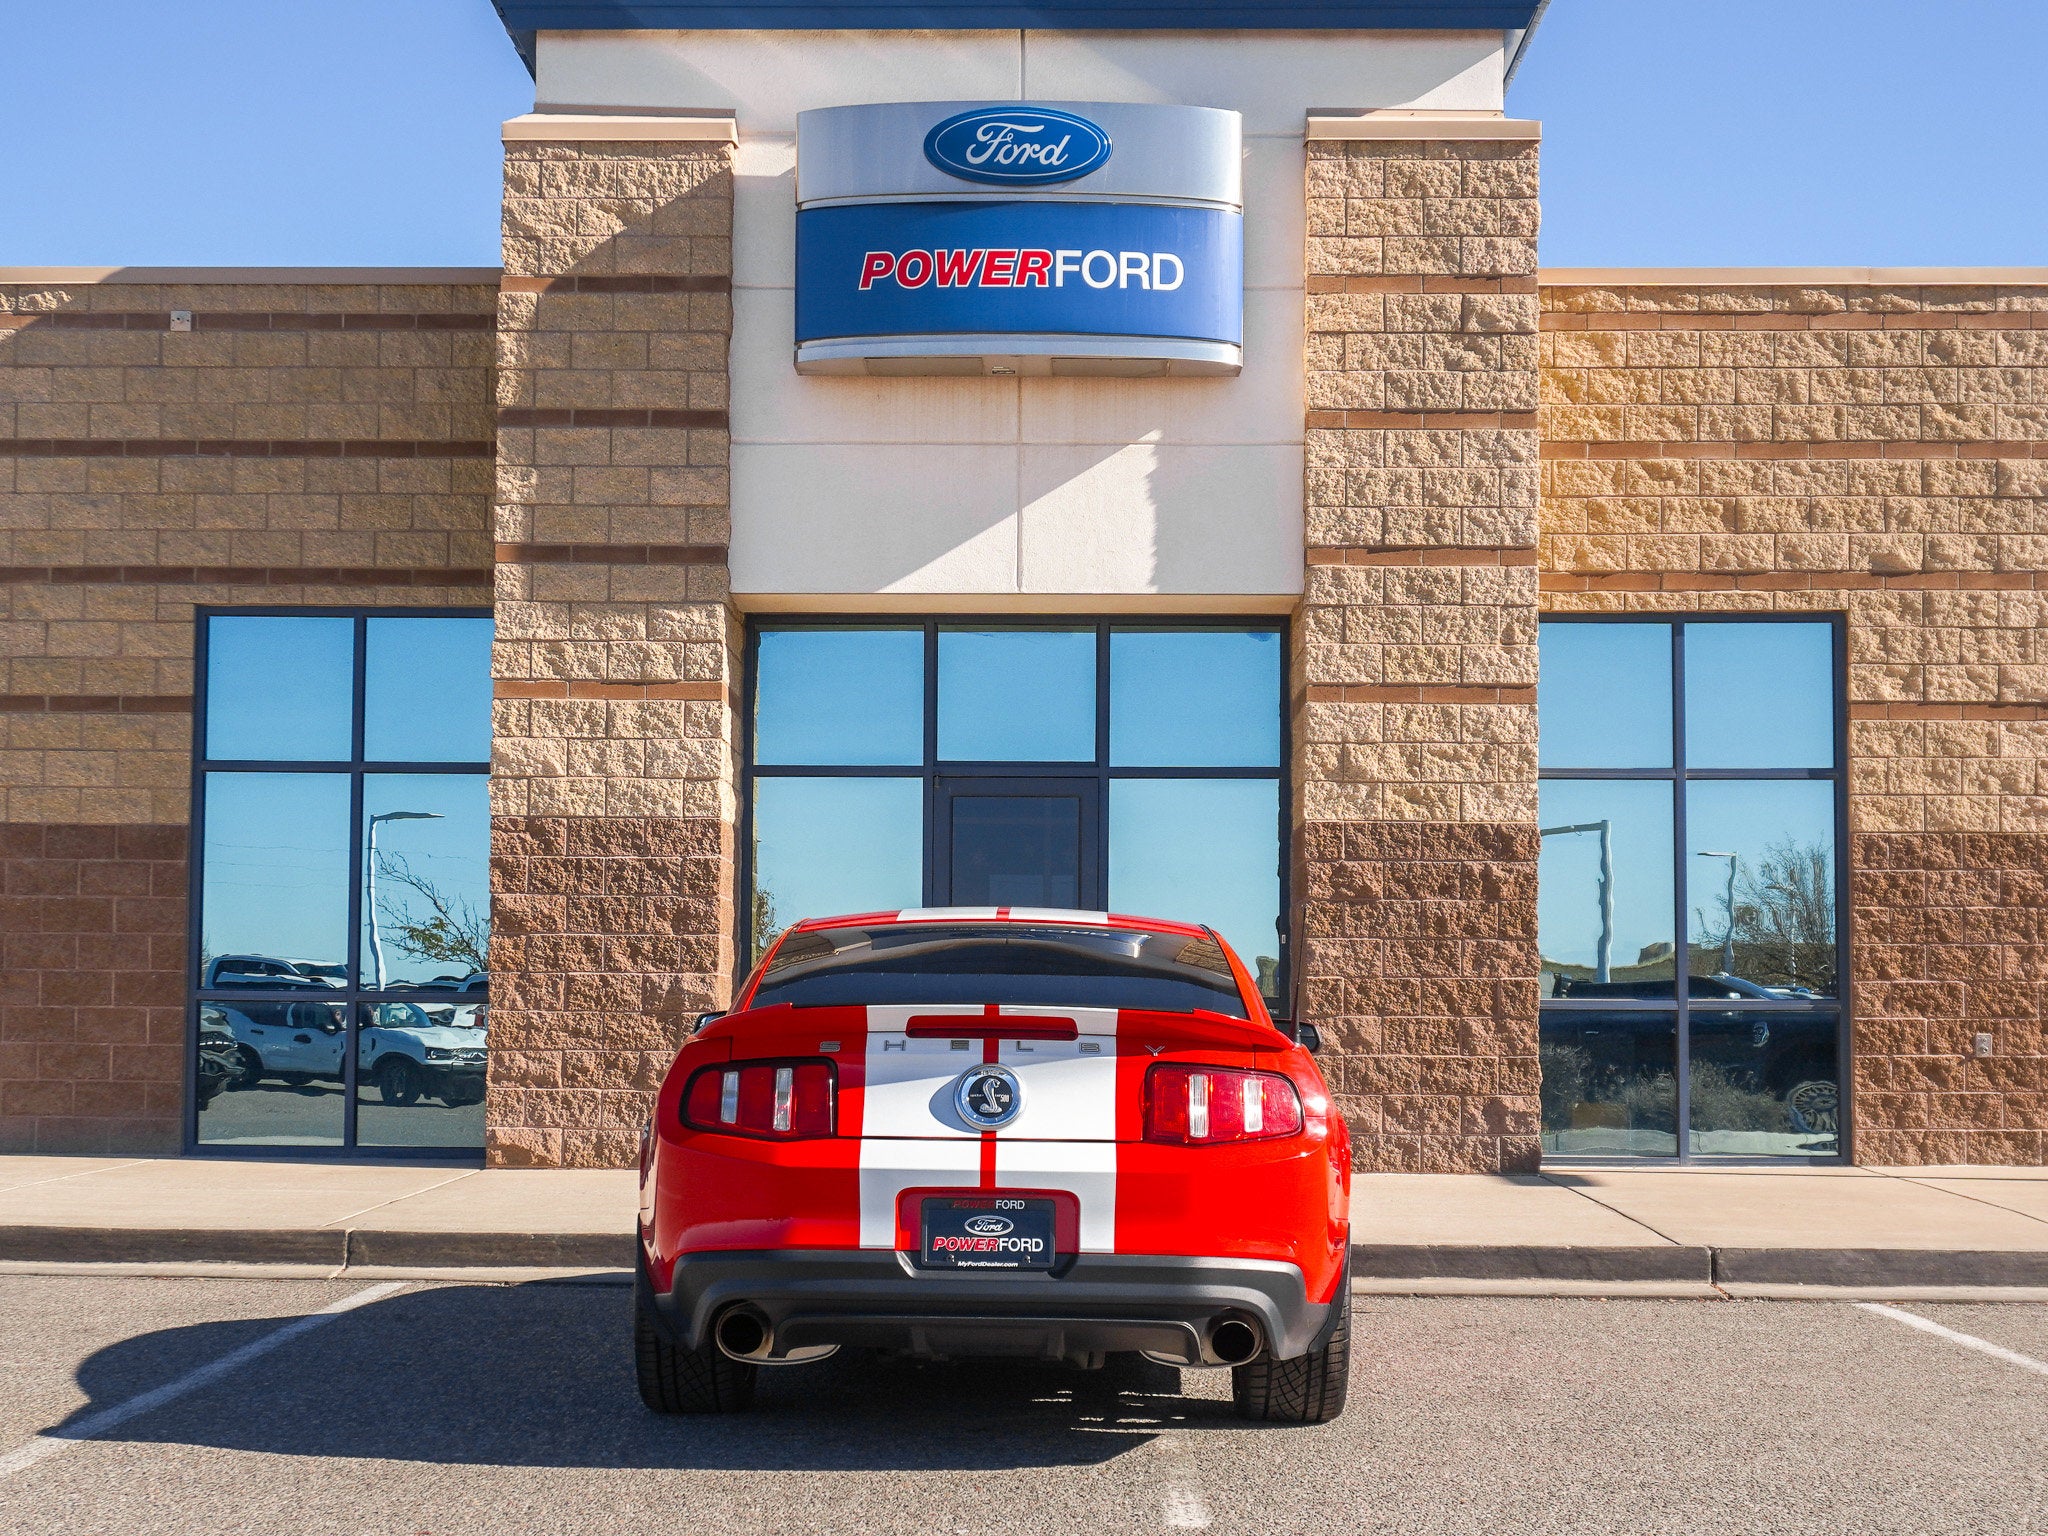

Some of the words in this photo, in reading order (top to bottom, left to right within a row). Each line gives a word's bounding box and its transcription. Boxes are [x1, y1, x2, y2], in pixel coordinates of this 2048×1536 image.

[966, 121, 1072, 167] Ford
[858, 248, 1185, 291] POWERFORD
[819, 1039, 1166, 1057] SHELBY
[974, 1219, 1004, 1232] Ford
[932, 1236, 1044, 1252] POWERFORD
